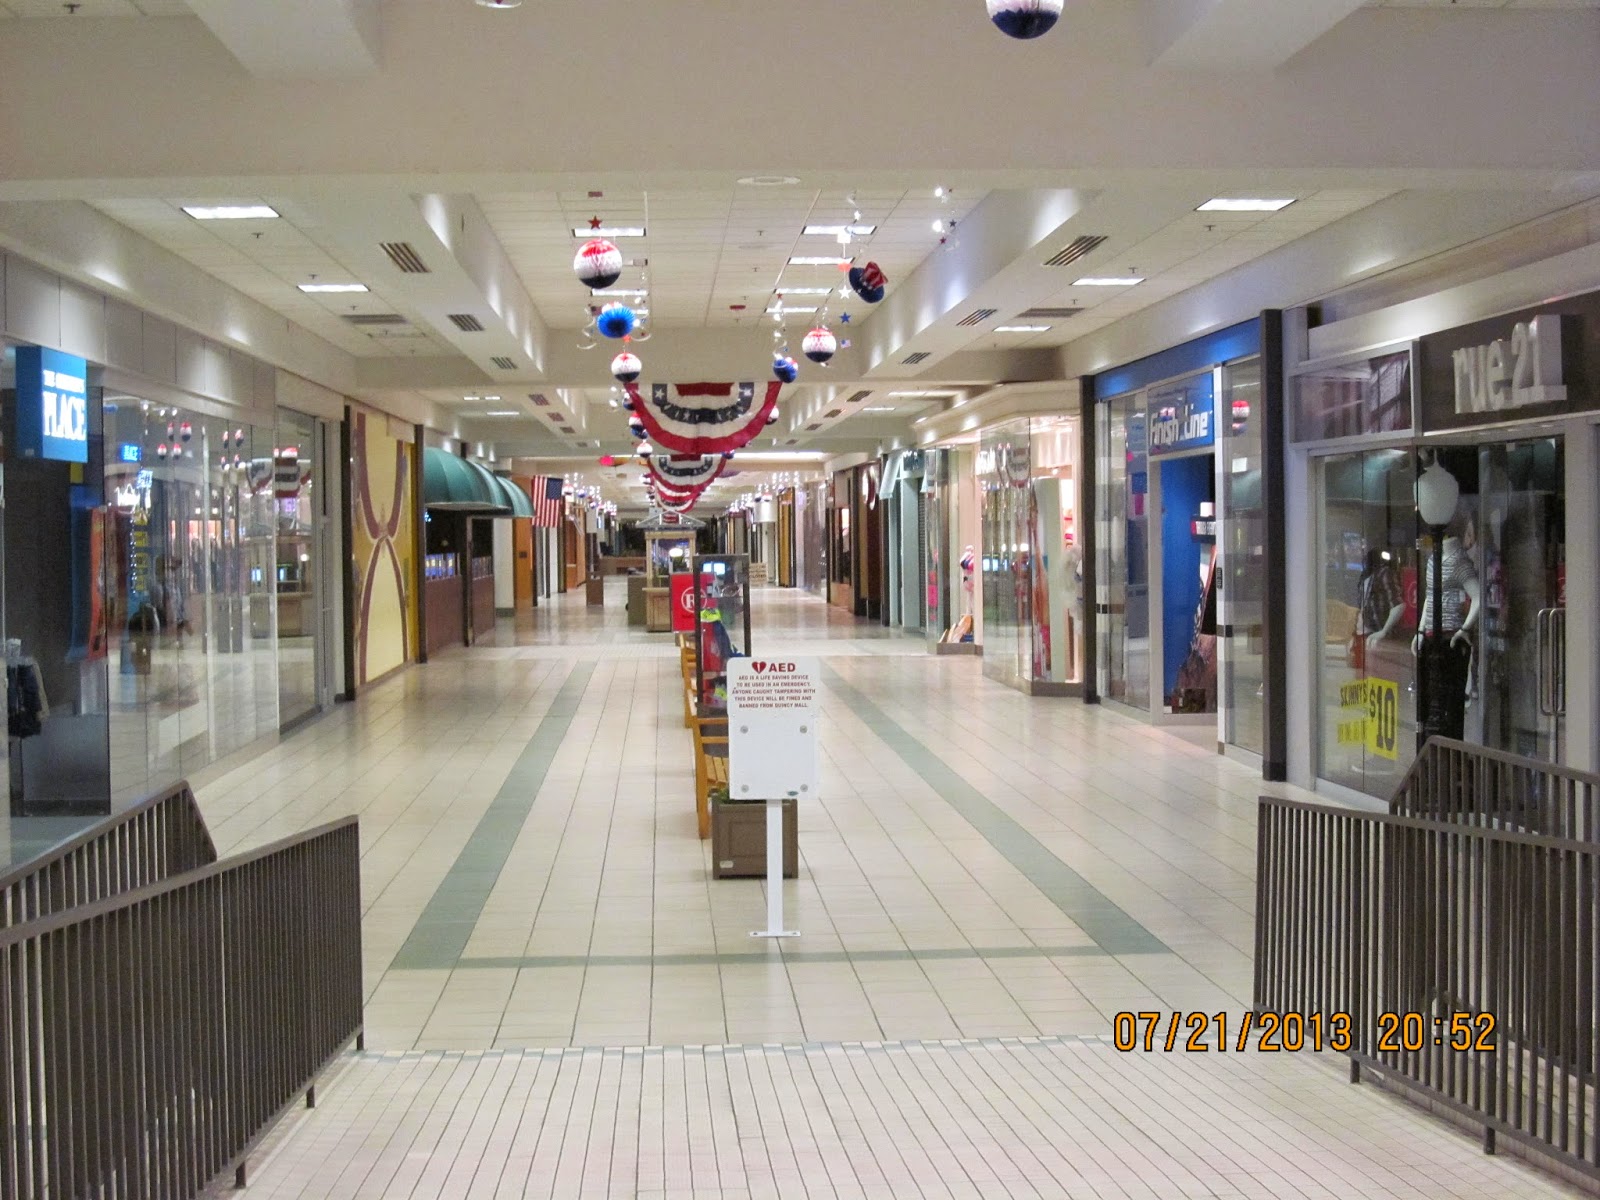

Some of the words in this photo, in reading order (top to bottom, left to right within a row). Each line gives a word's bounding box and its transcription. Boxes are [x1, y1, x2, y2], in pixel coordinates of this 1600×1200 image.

[42, 391, 86, 441] PLACE
[1184, 404, 1209, 440] Line
[769, 663, 796, 672] AED
[1369, 684, 1396, 751] $10
